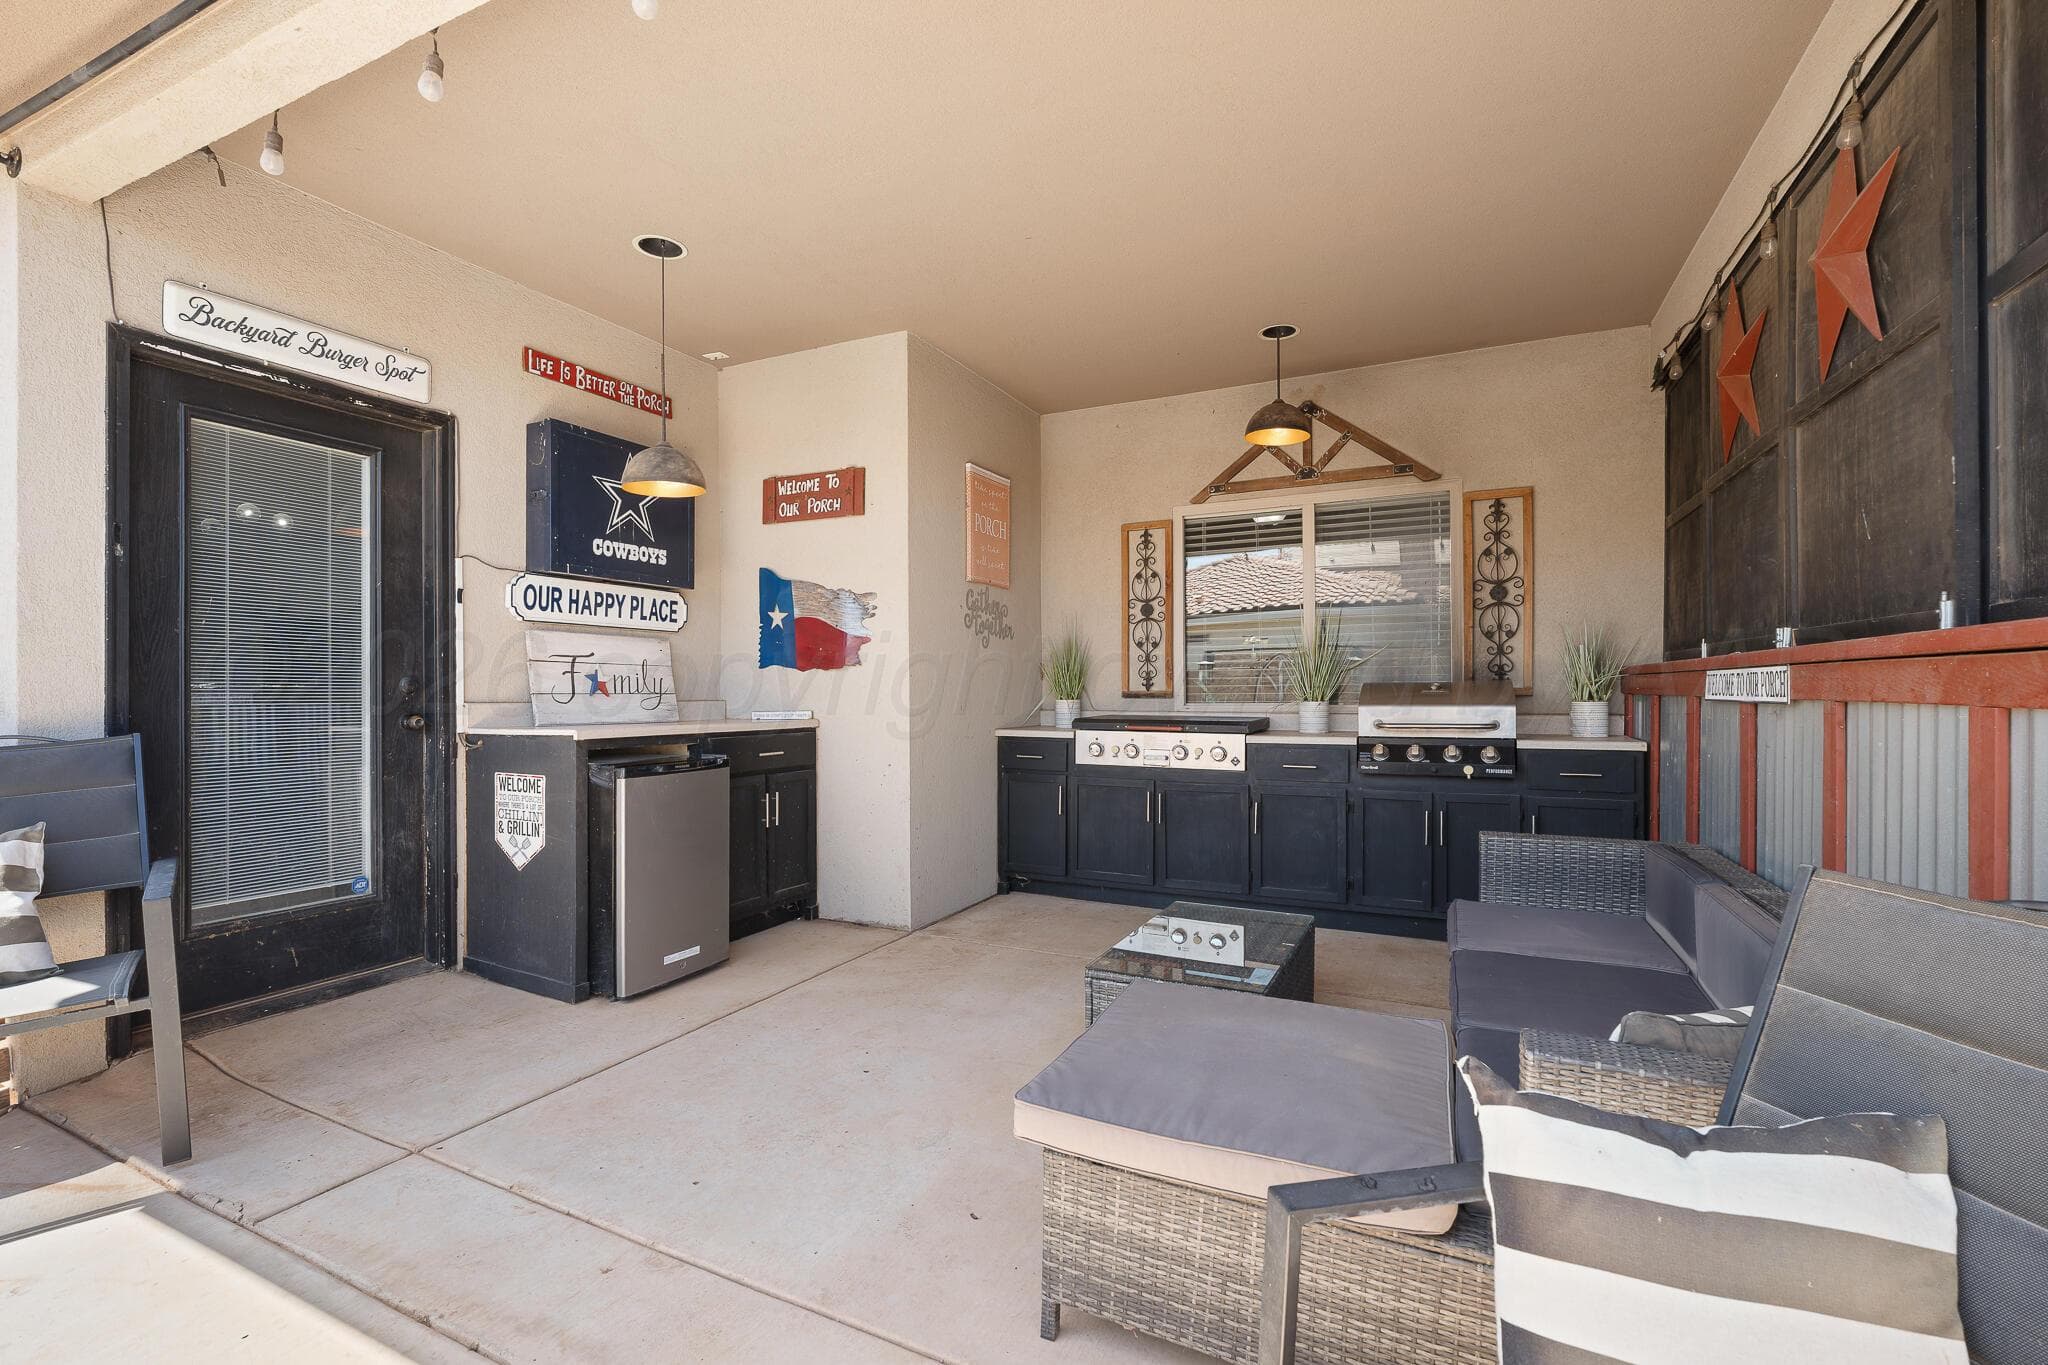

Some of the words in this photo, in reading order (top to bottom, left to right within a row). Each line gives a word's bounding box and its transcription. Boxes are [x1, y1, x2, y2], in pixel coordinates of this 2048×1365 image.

[178, 296, 298, 348] Backyard
[298, 331, 369, 372] Burger
[375, 354, 427, 382] Spot
[618, 391, 635, 406] THE
[619, 381, 634, 395] ON
[975, 513, 1007, 540] PORCH
[592, 538, 668, 566] COWBOYS
[523, 583, 563, 614] OUR
[568, 588, 627, 619] HAPPY
[629, 595, 679, 624] PLACE
[547, 651, 669, 711] Fmily
[1707, 673, 1735, 696] WELCOME
[1736, 672, 1745, 697] TO
[1745, 671, 1760, 698] OUR
[1760, 669, 1788, 698] PORCH
[498, 776, 542, 793] WELCOME
[498, 820, 504, 834] &
